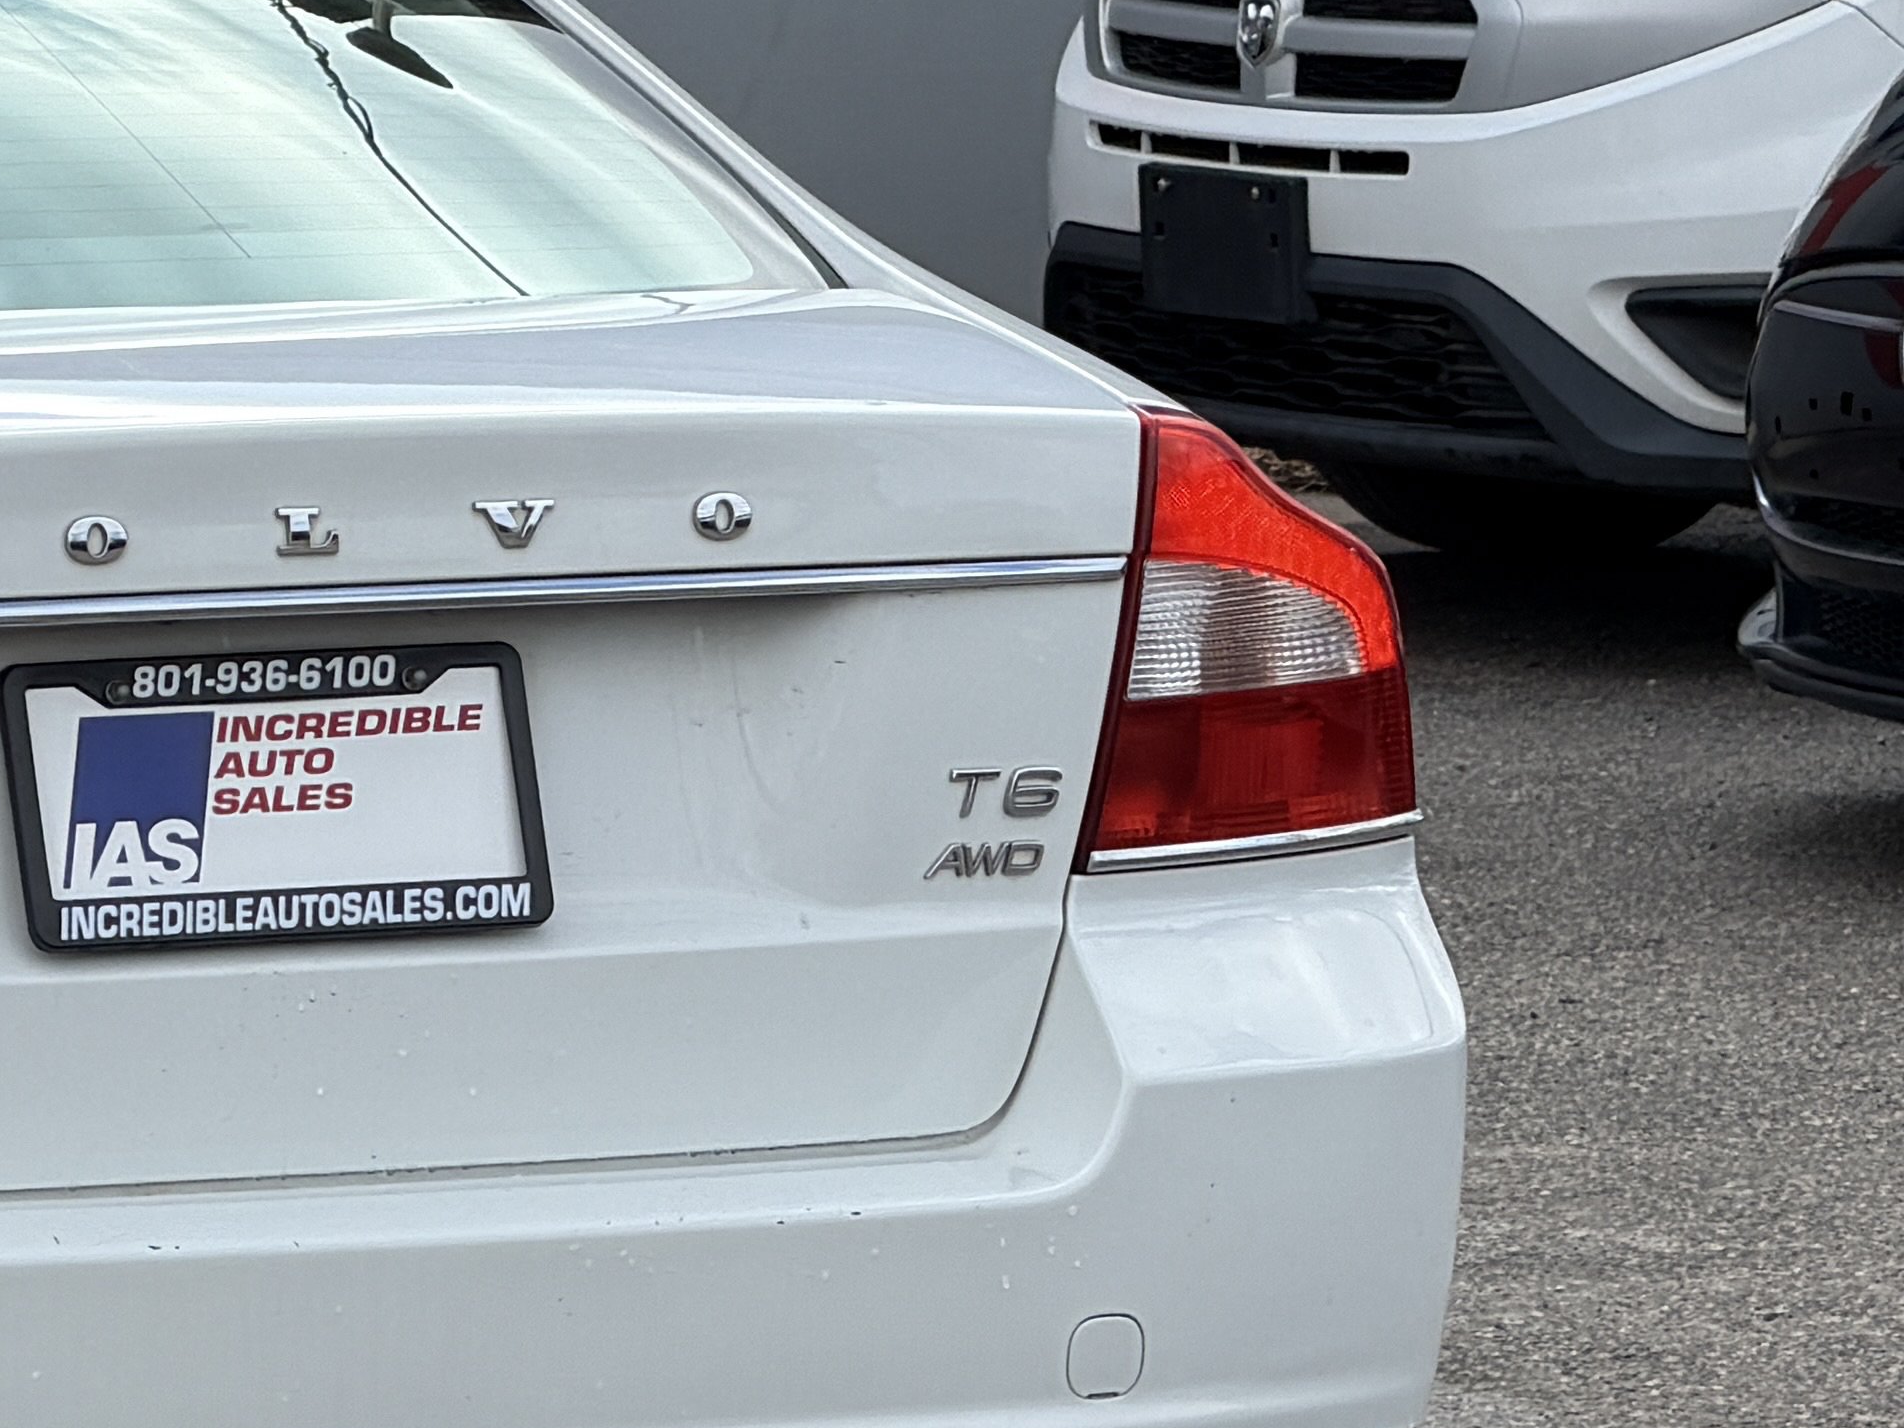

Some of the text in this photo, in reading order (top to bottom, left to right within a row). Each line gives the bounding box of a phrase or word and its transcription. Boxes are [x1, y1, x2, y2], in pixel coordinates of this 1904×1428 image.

[132, 654, 397, 700] 801-936-6100
[215, 703, 484, 744] INCREDIBLE
[213, 747, 335, 780] AUTO
[212, 782, 353, 816] SALES
[949, 765, 1063, 819] T6
[69, 818, 200, 890] IAS
[923, 839, 1044, 880] AWD
[59, 882, 532, 942] INCREDIBLEAUTOSALES.COM
